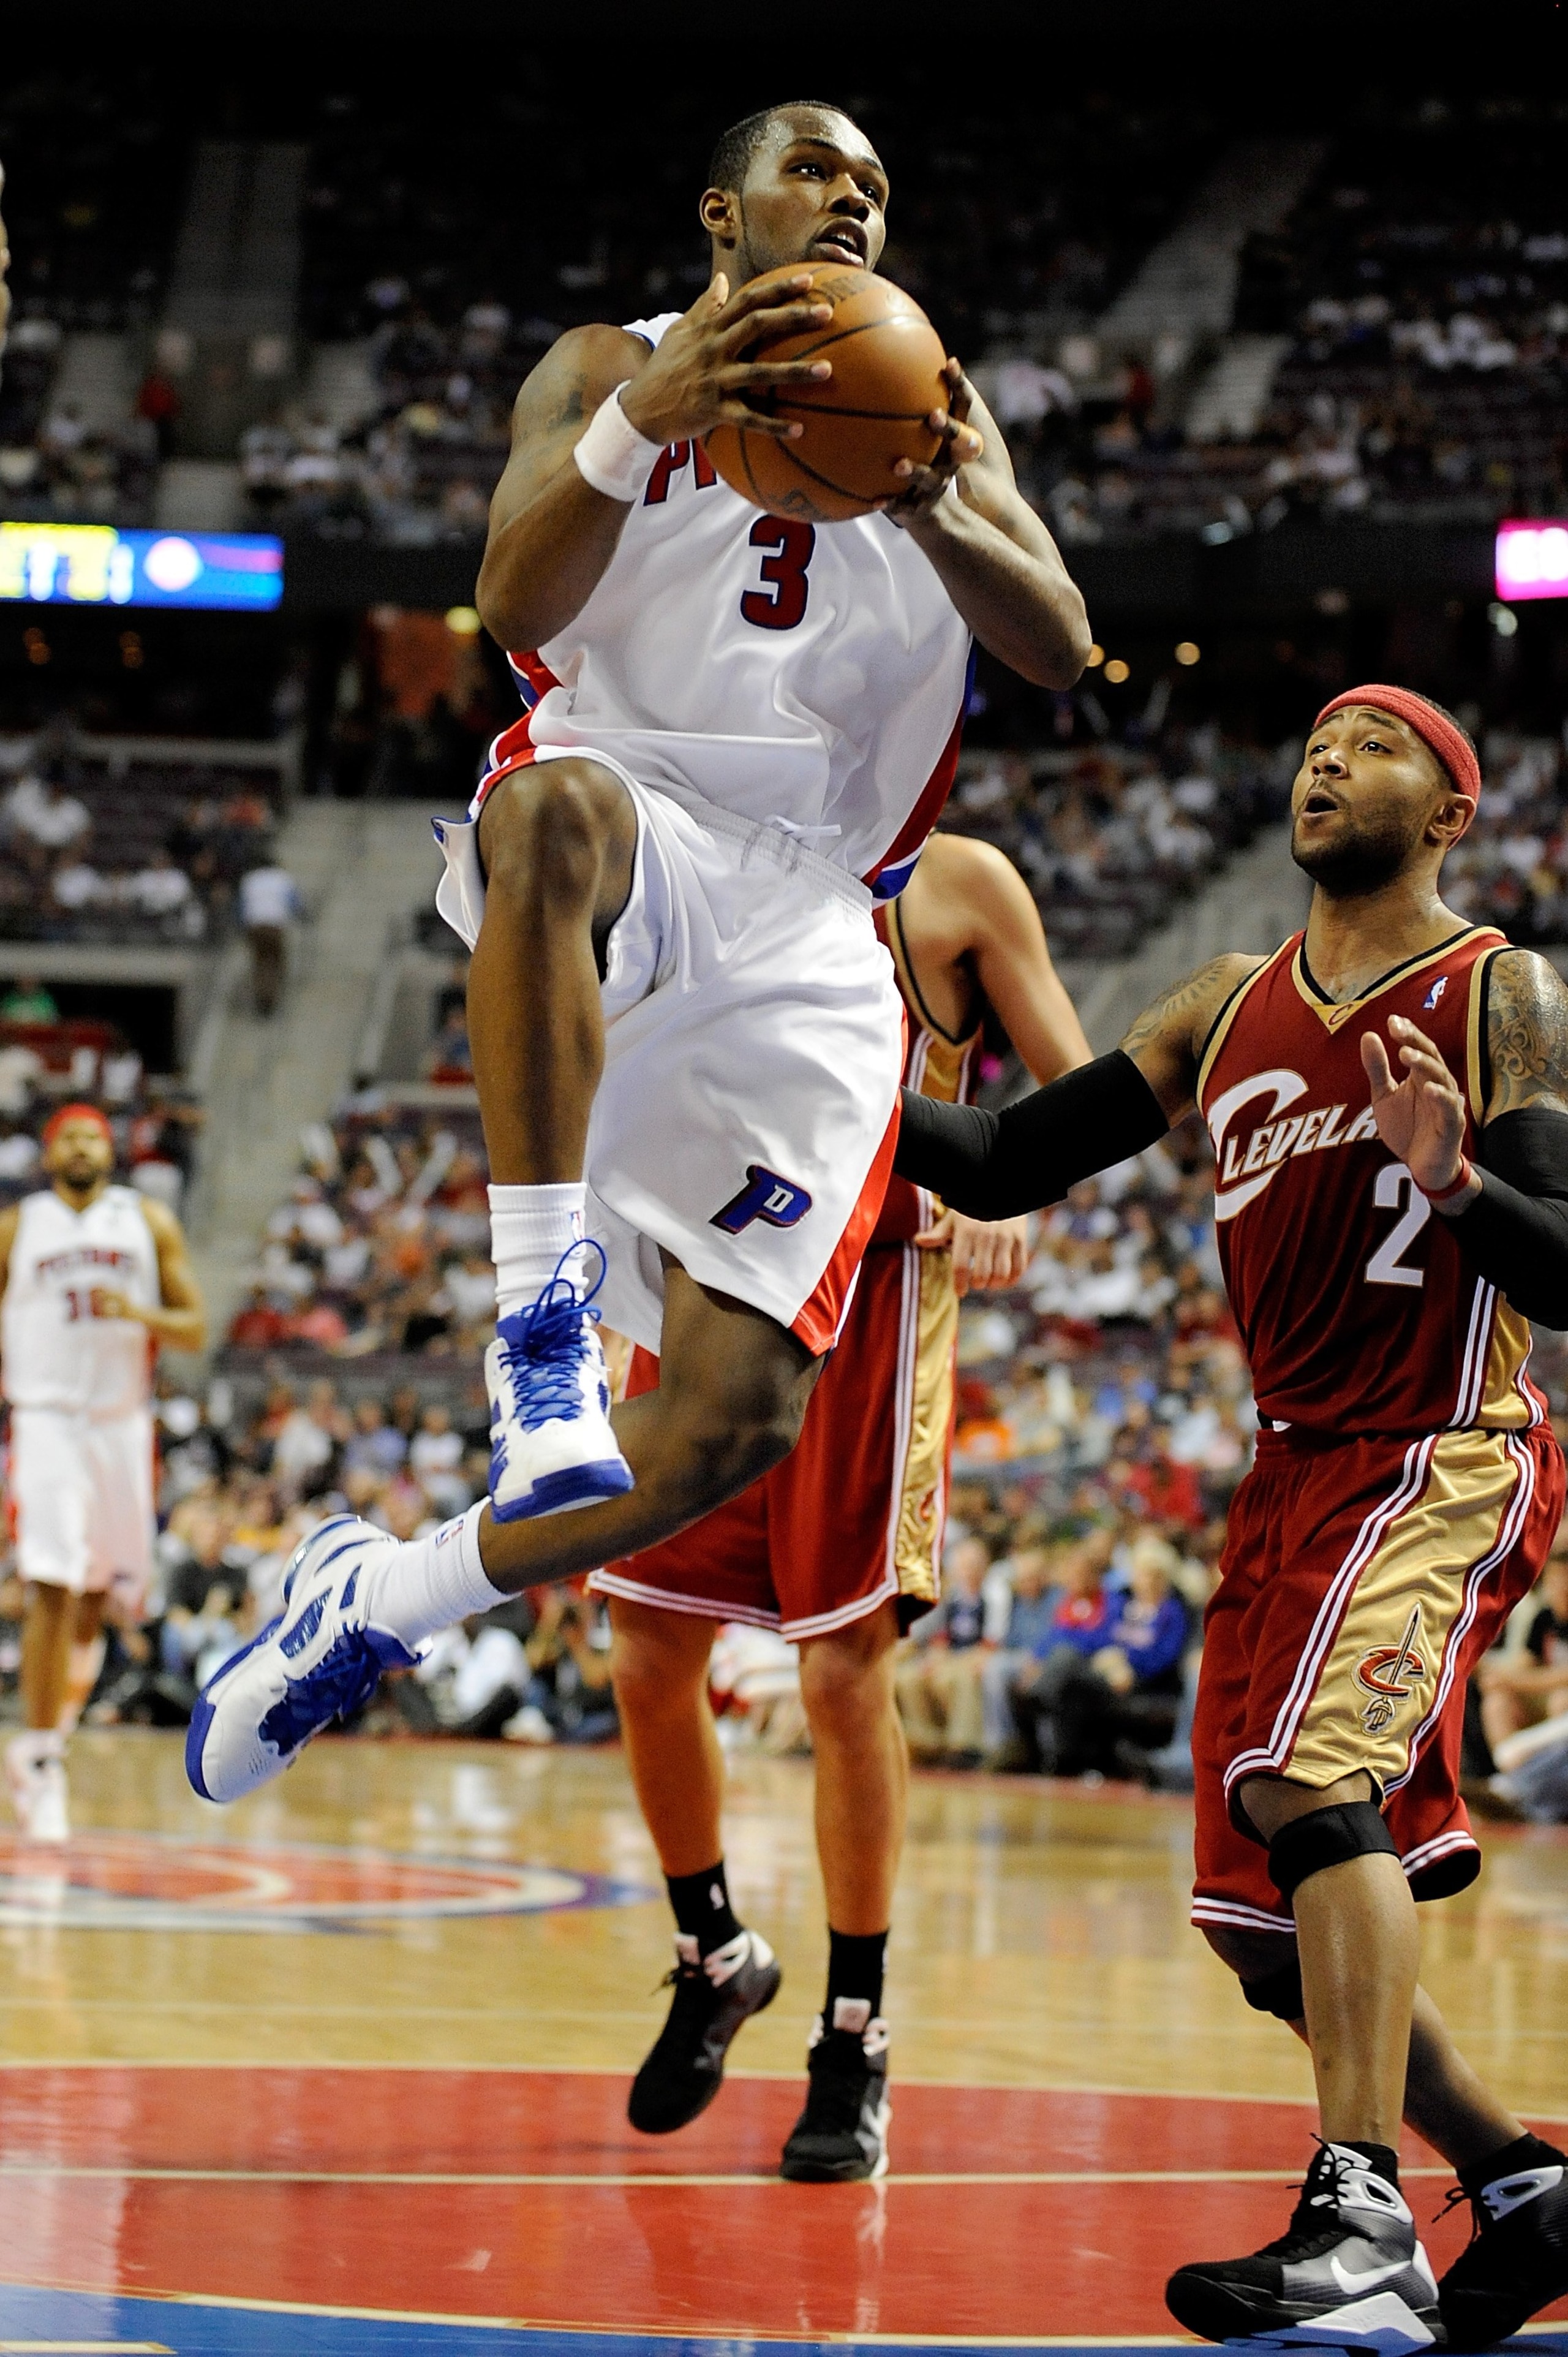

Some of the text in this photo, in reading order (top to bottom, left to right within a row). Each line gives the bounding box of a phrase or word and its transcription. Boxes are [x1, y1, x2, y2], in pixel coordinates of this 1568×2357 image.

[741, 514, 815, 630] 3
[1207, 1069, 1381, 1222] CLEVELA
[1365, 1162, 1431, 1287] 2
